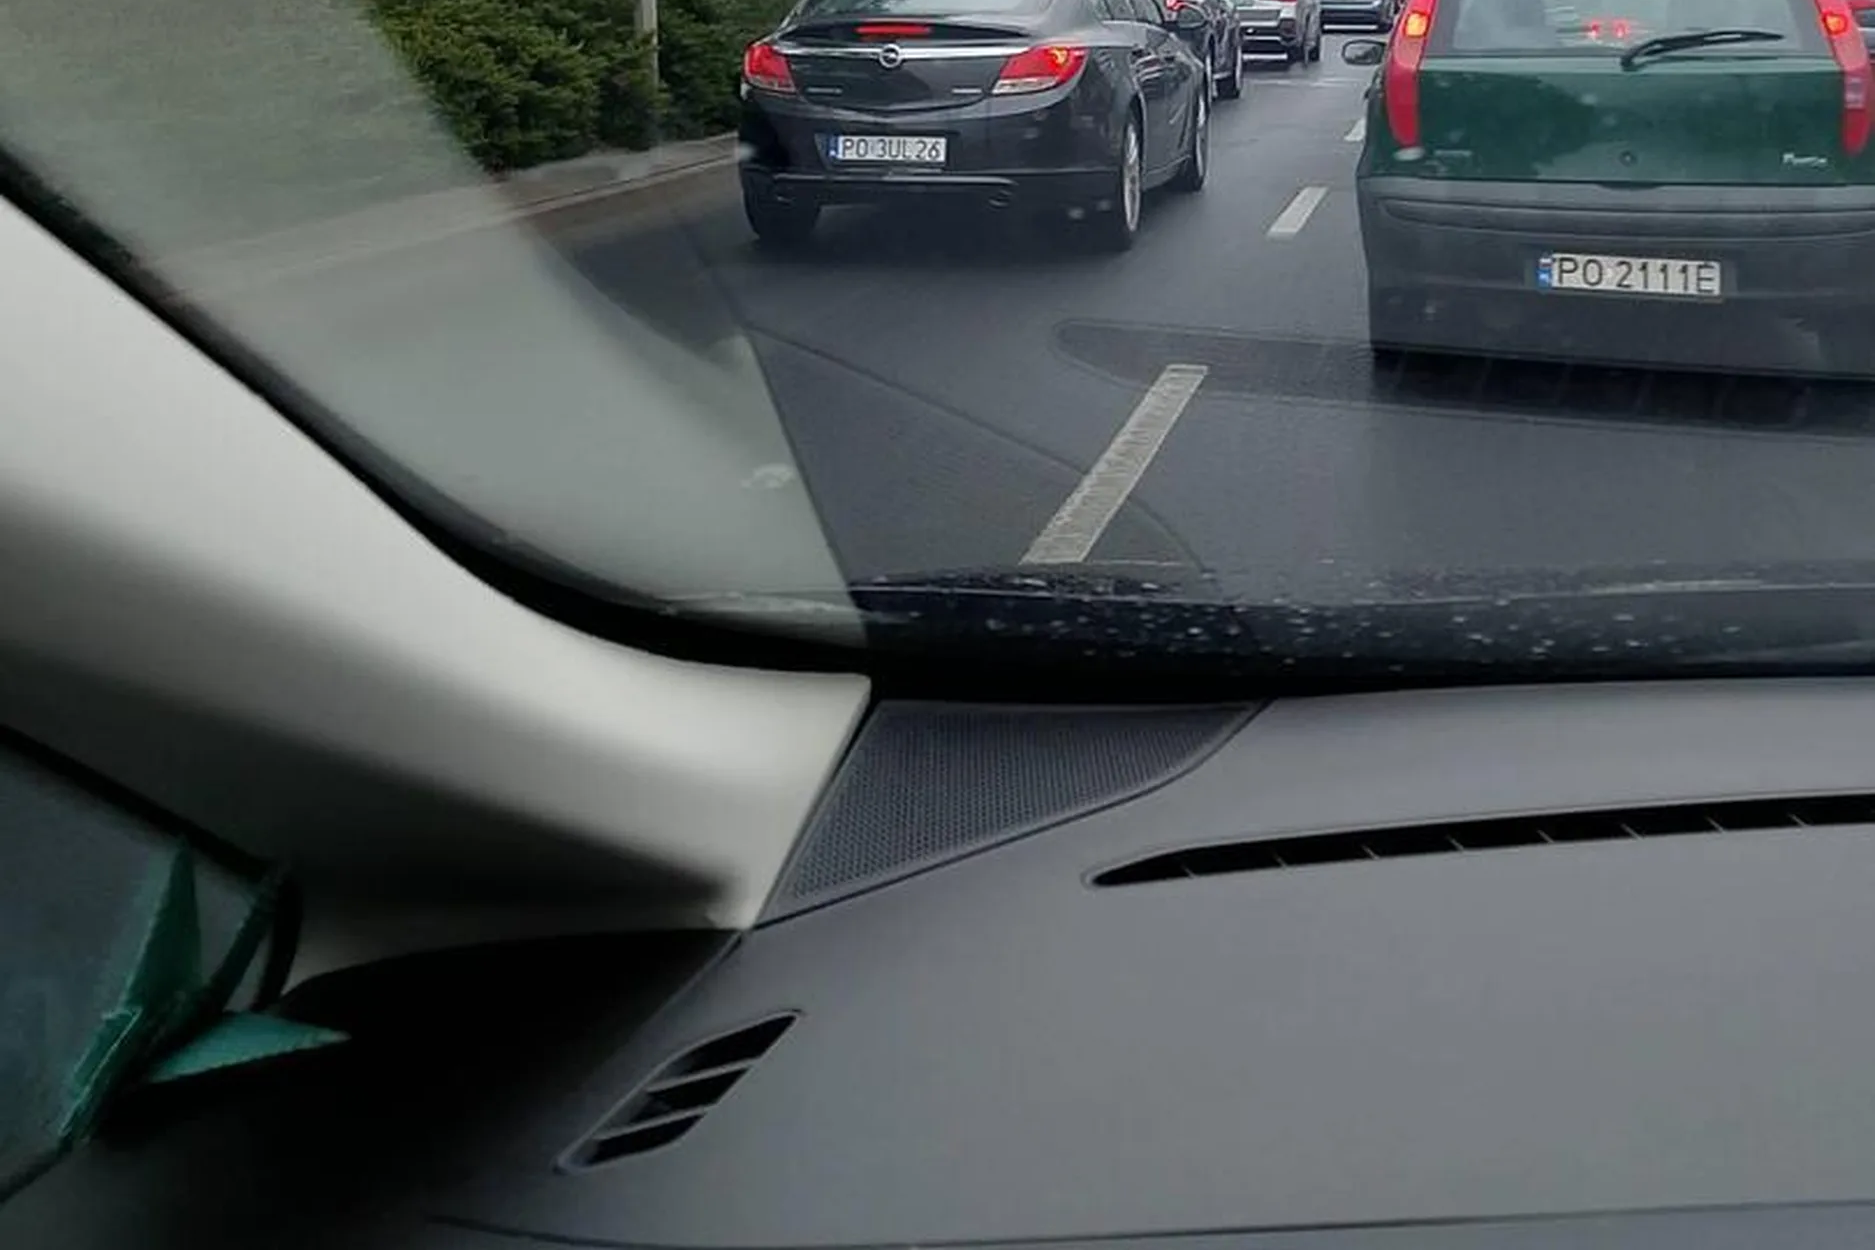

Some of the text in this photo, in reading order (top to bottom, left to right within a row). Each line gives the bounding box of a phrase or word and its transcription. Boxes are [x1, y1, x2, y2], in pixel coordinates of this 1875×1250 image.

[842, 138, 869, 158] PO
[1558, 257, 1714, 293] PO 2111E
